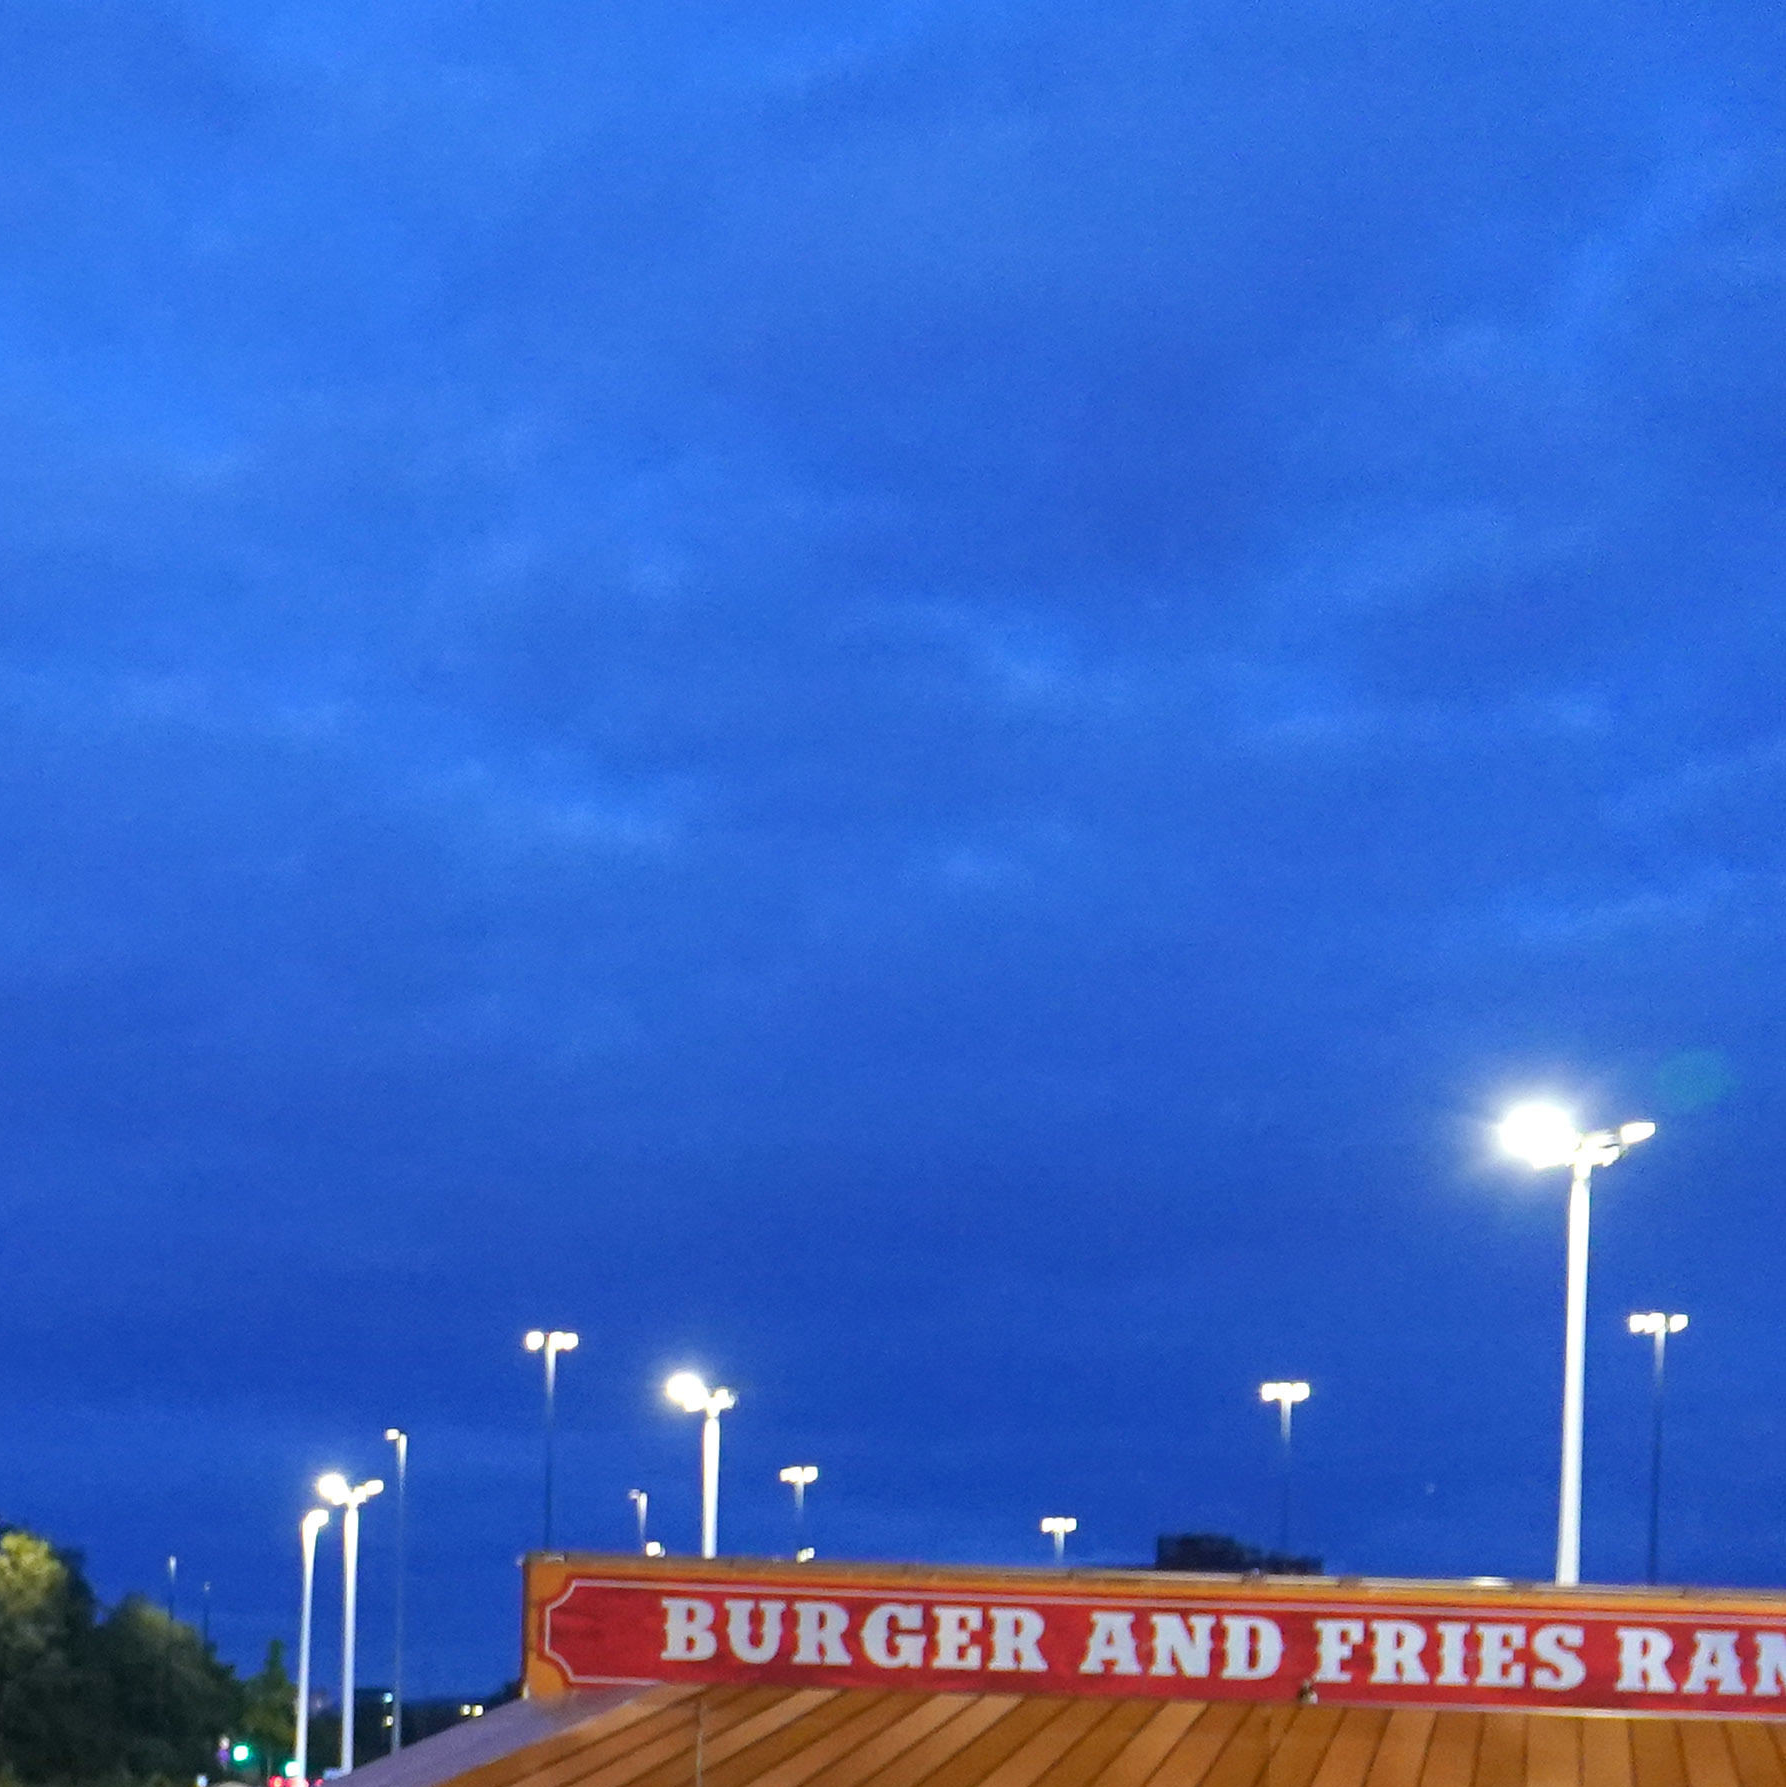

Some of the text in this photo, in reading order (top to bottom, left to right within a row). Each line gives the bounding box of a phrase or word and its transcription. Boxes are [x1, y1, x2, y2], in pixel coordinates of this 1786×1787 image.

[661, 1597, 1048, 1672] BURGER
[1078, 1611, 1282, 1680] AND
[1314, 1619, 1586, 1690] FRIES
